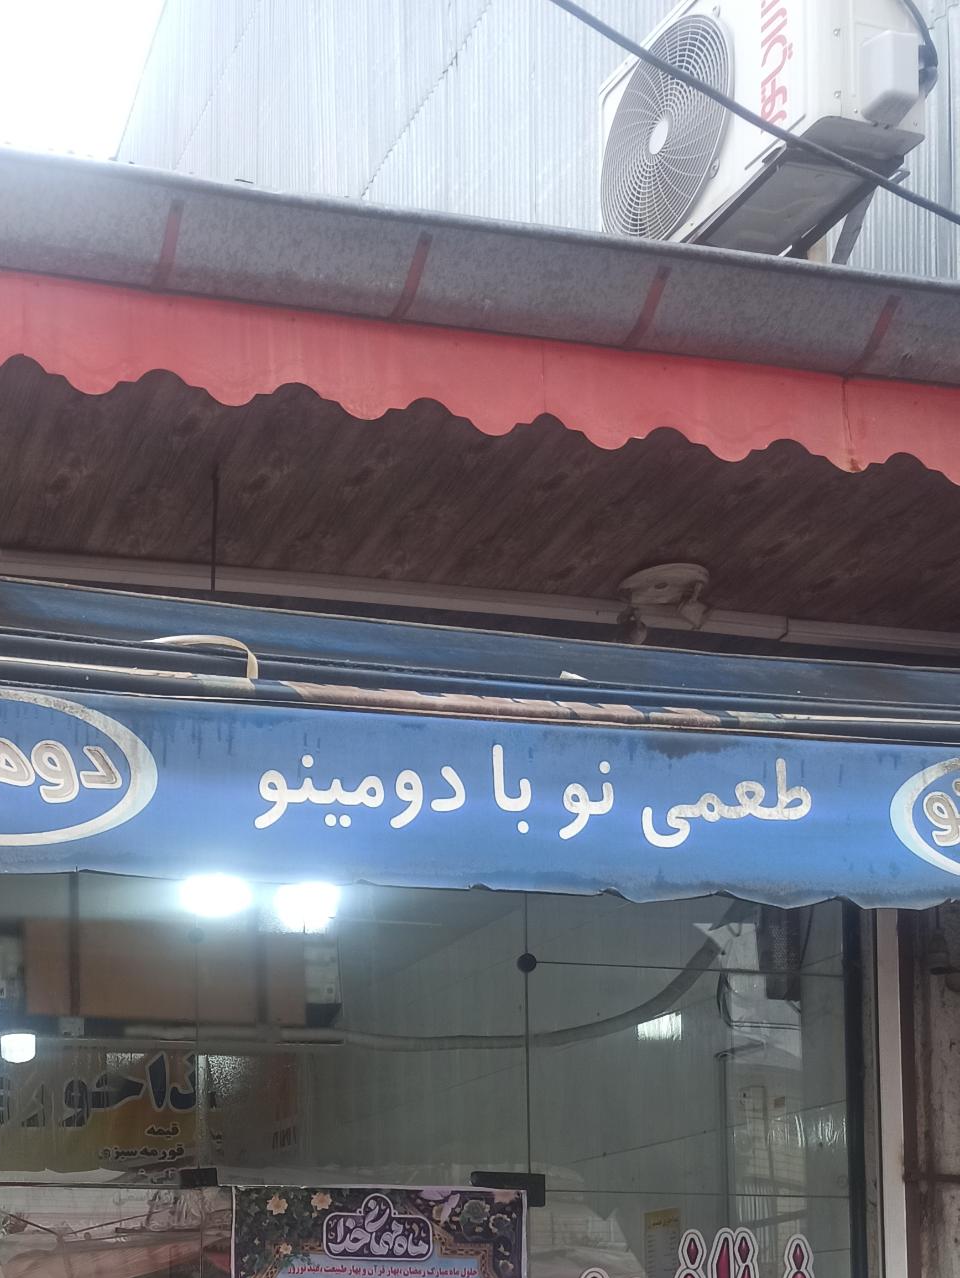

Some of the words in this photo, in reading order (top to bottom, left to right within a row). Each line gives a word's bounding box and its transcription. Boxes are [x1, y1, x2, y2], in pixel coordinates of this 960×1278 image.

[253, 754, 466, 829] دومینو
[492, 744, 531, 834] با
[558, 761, 615, 840] نو
[642, 757, 813, 848] طعمی
[403, 1266, 425, 1277] رمضان
[427, 1267, 448, 1277] مبارک
[449, 1268, 459, 1276] ماه
